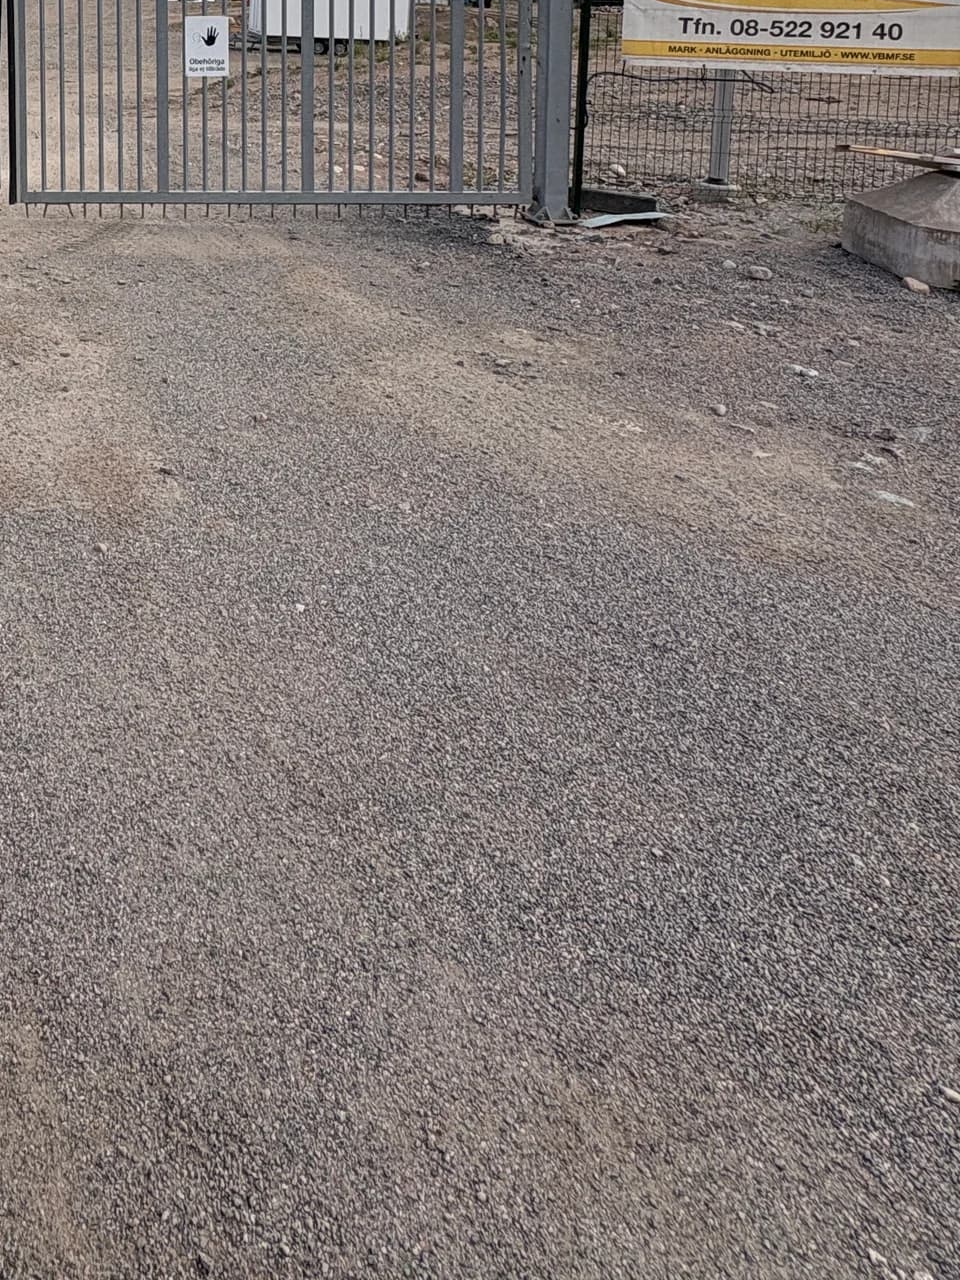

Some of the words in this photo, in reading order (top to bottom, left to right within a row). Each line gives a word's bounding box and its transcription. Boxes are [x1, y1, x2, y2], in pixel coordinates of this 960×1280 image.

[678, 17, 722, 35] Tfn.
[730, 19, 813, 38] 08-522
[820, 21, 862, 39] 921
[872, 23, 903, 41] 40
[668, 45, 697, 54] MARK
[704, 45, 772, 57] ANLÄGGNING
[780, 48, 832, 59] UTEMILJÖ
[840, 51, 916, 61] WWW.VBMF.SE
[189, 57, 225, 66] Obehöriga
